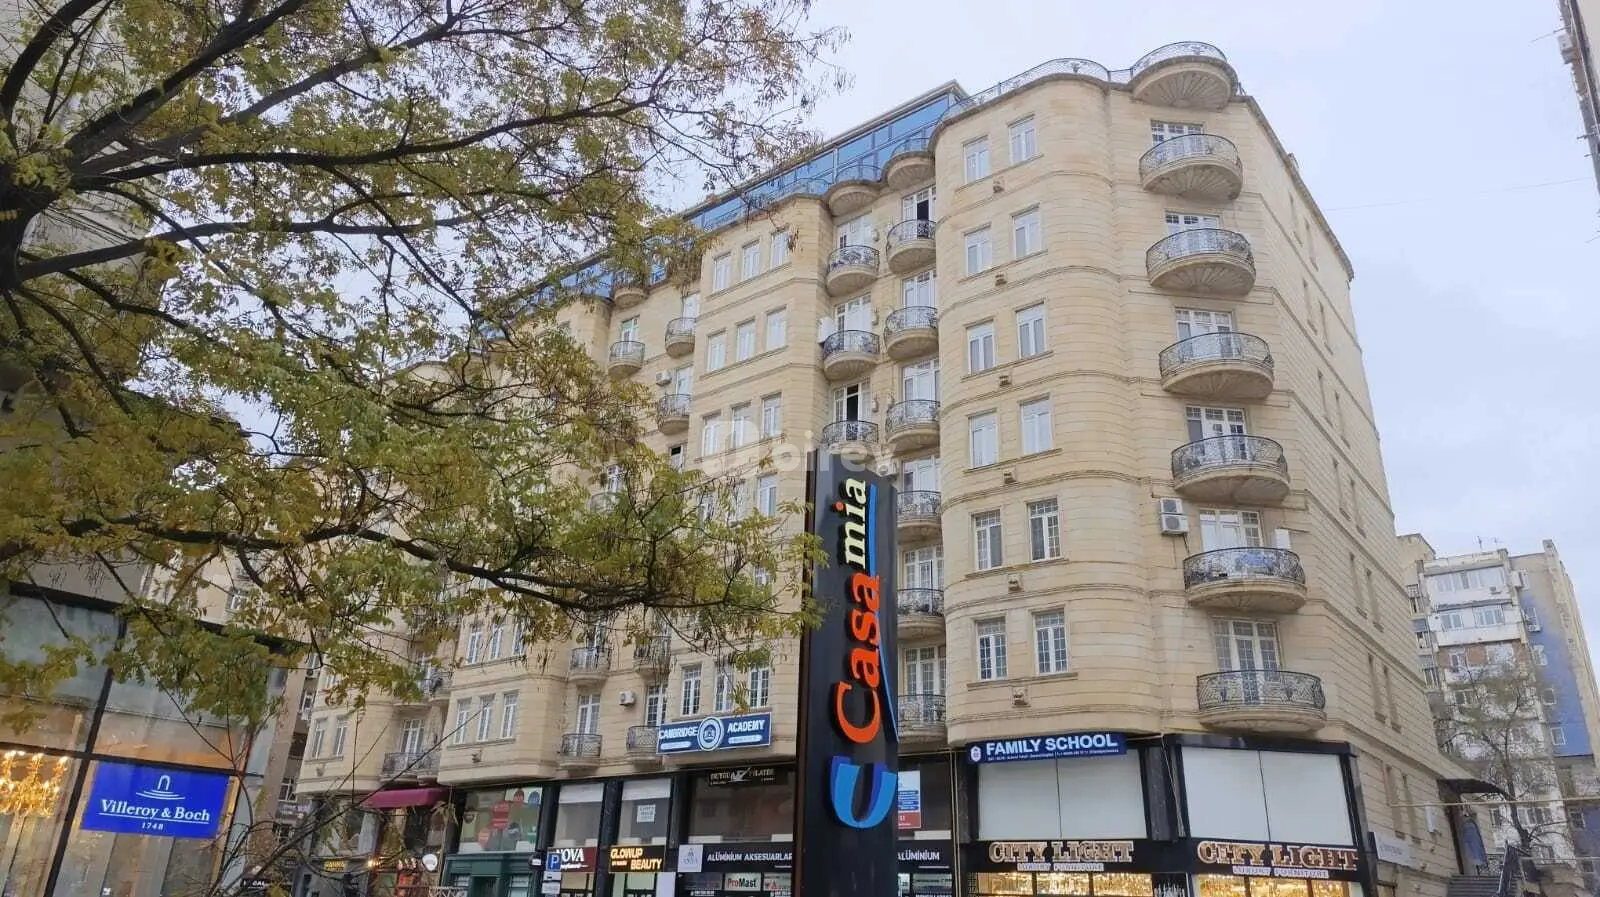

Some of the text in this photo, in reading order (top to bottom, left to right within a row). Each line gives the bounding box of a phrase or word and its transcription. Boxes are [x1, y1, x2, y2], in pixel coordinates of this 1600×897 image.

[835, 477, 867, 570] mia
[836, 573, 880, 743] Casa
[727, 719, 765, 734] ACADEMY
[986, 740, 1041, 757] FAMILY
[1045, 734, 1119, 751] SCHOOL
[101, 799, 210, 821] Villeroy & Boch
[141, 822, 164, 831] 1748
[611, 848, 643, 859] GLOWUP
[989, 841, 1134, 862] CITY LIGHT
[1197, 841, 1266, 865] CITY
[1270, 844, 1358, 871] LIGHT
[630, 859, 663, 870] BEAUTY
[727, 877, 757, 889] ProMast
